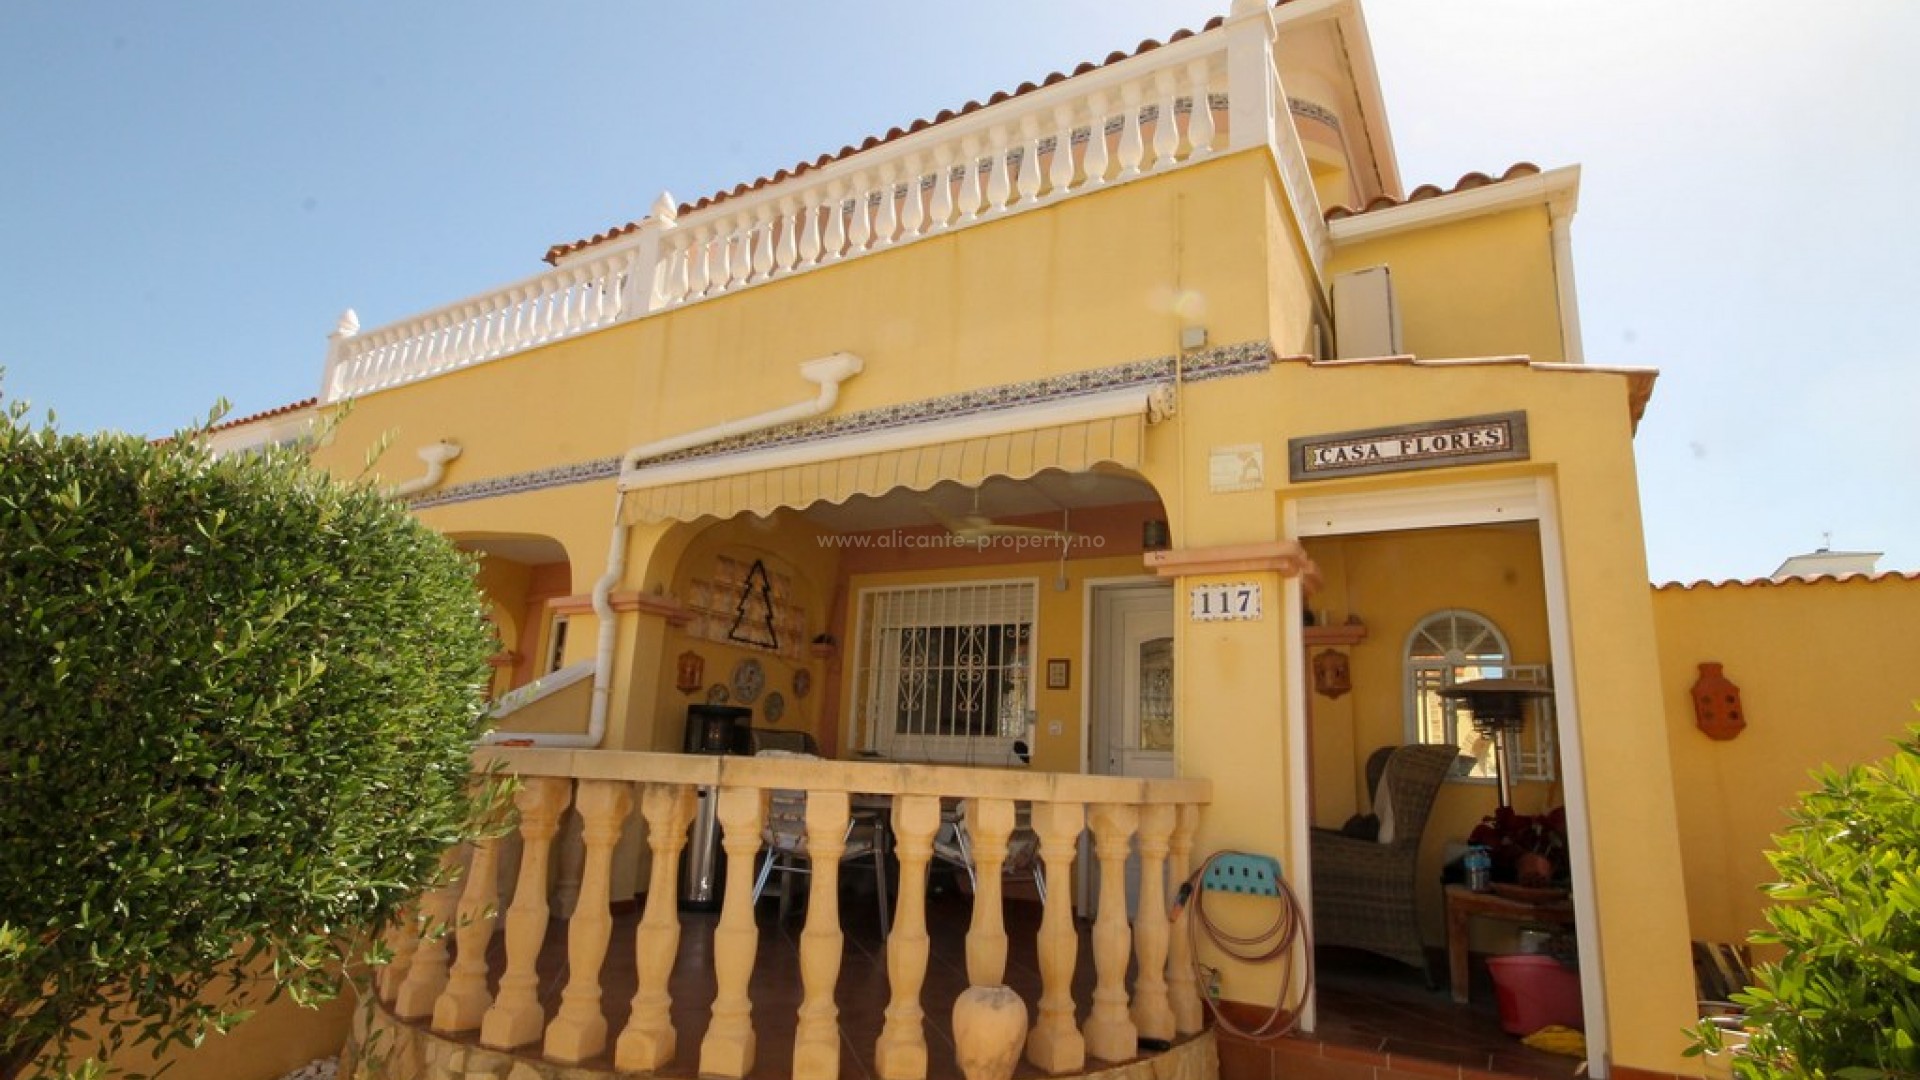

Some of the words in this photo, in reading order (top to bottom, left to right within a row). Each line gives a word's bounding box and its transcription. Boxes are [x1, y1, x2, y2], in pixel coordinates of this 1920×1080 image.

[1320, 444, 1380, 463] CASA
[1400, 429, 1500, 454] FLORES
[1201, 590, 1251, 614] 117
